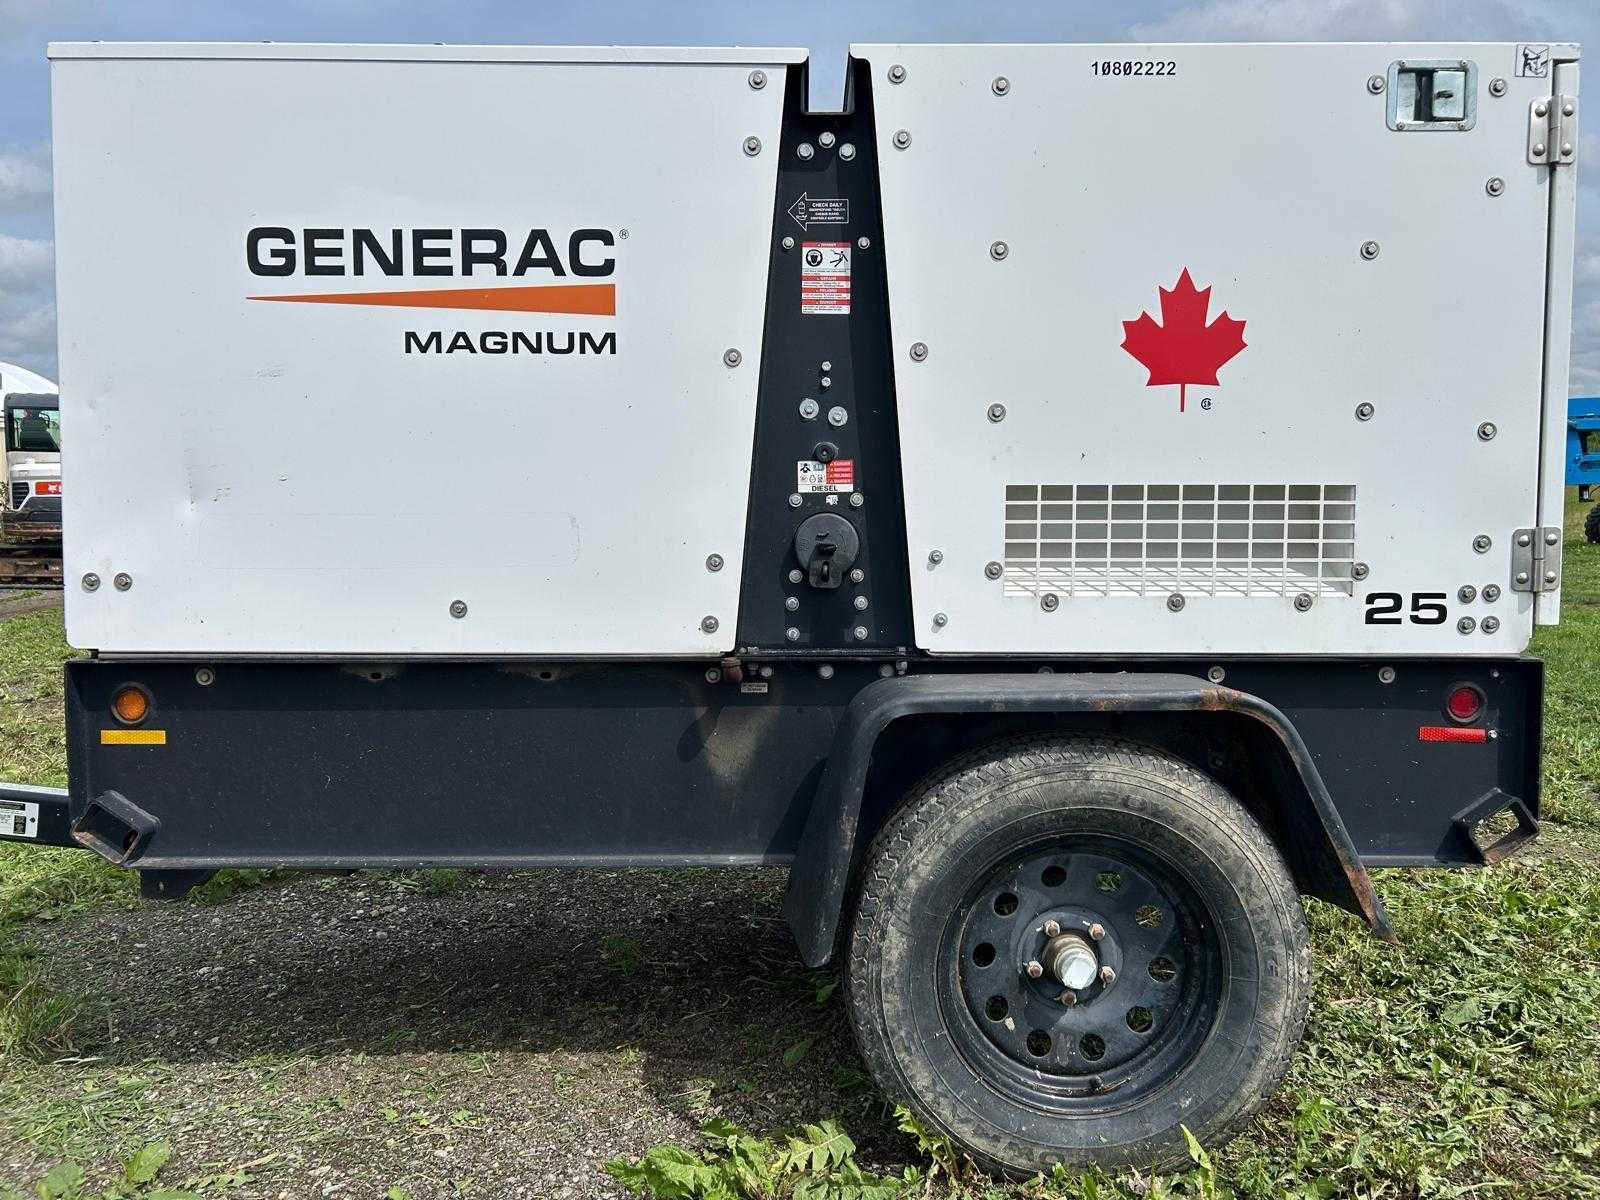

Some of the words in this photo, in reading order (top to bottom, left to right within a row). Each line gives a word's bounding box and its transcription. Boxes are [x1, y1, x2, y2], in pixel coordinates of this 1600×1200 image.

[1091, 61, 1176, 76] 10802222
[246, 226, 616, 277] GENERAC
[404, 331, 617, 354] MAGNUM
[1365, 593, 1447, 625] 25
